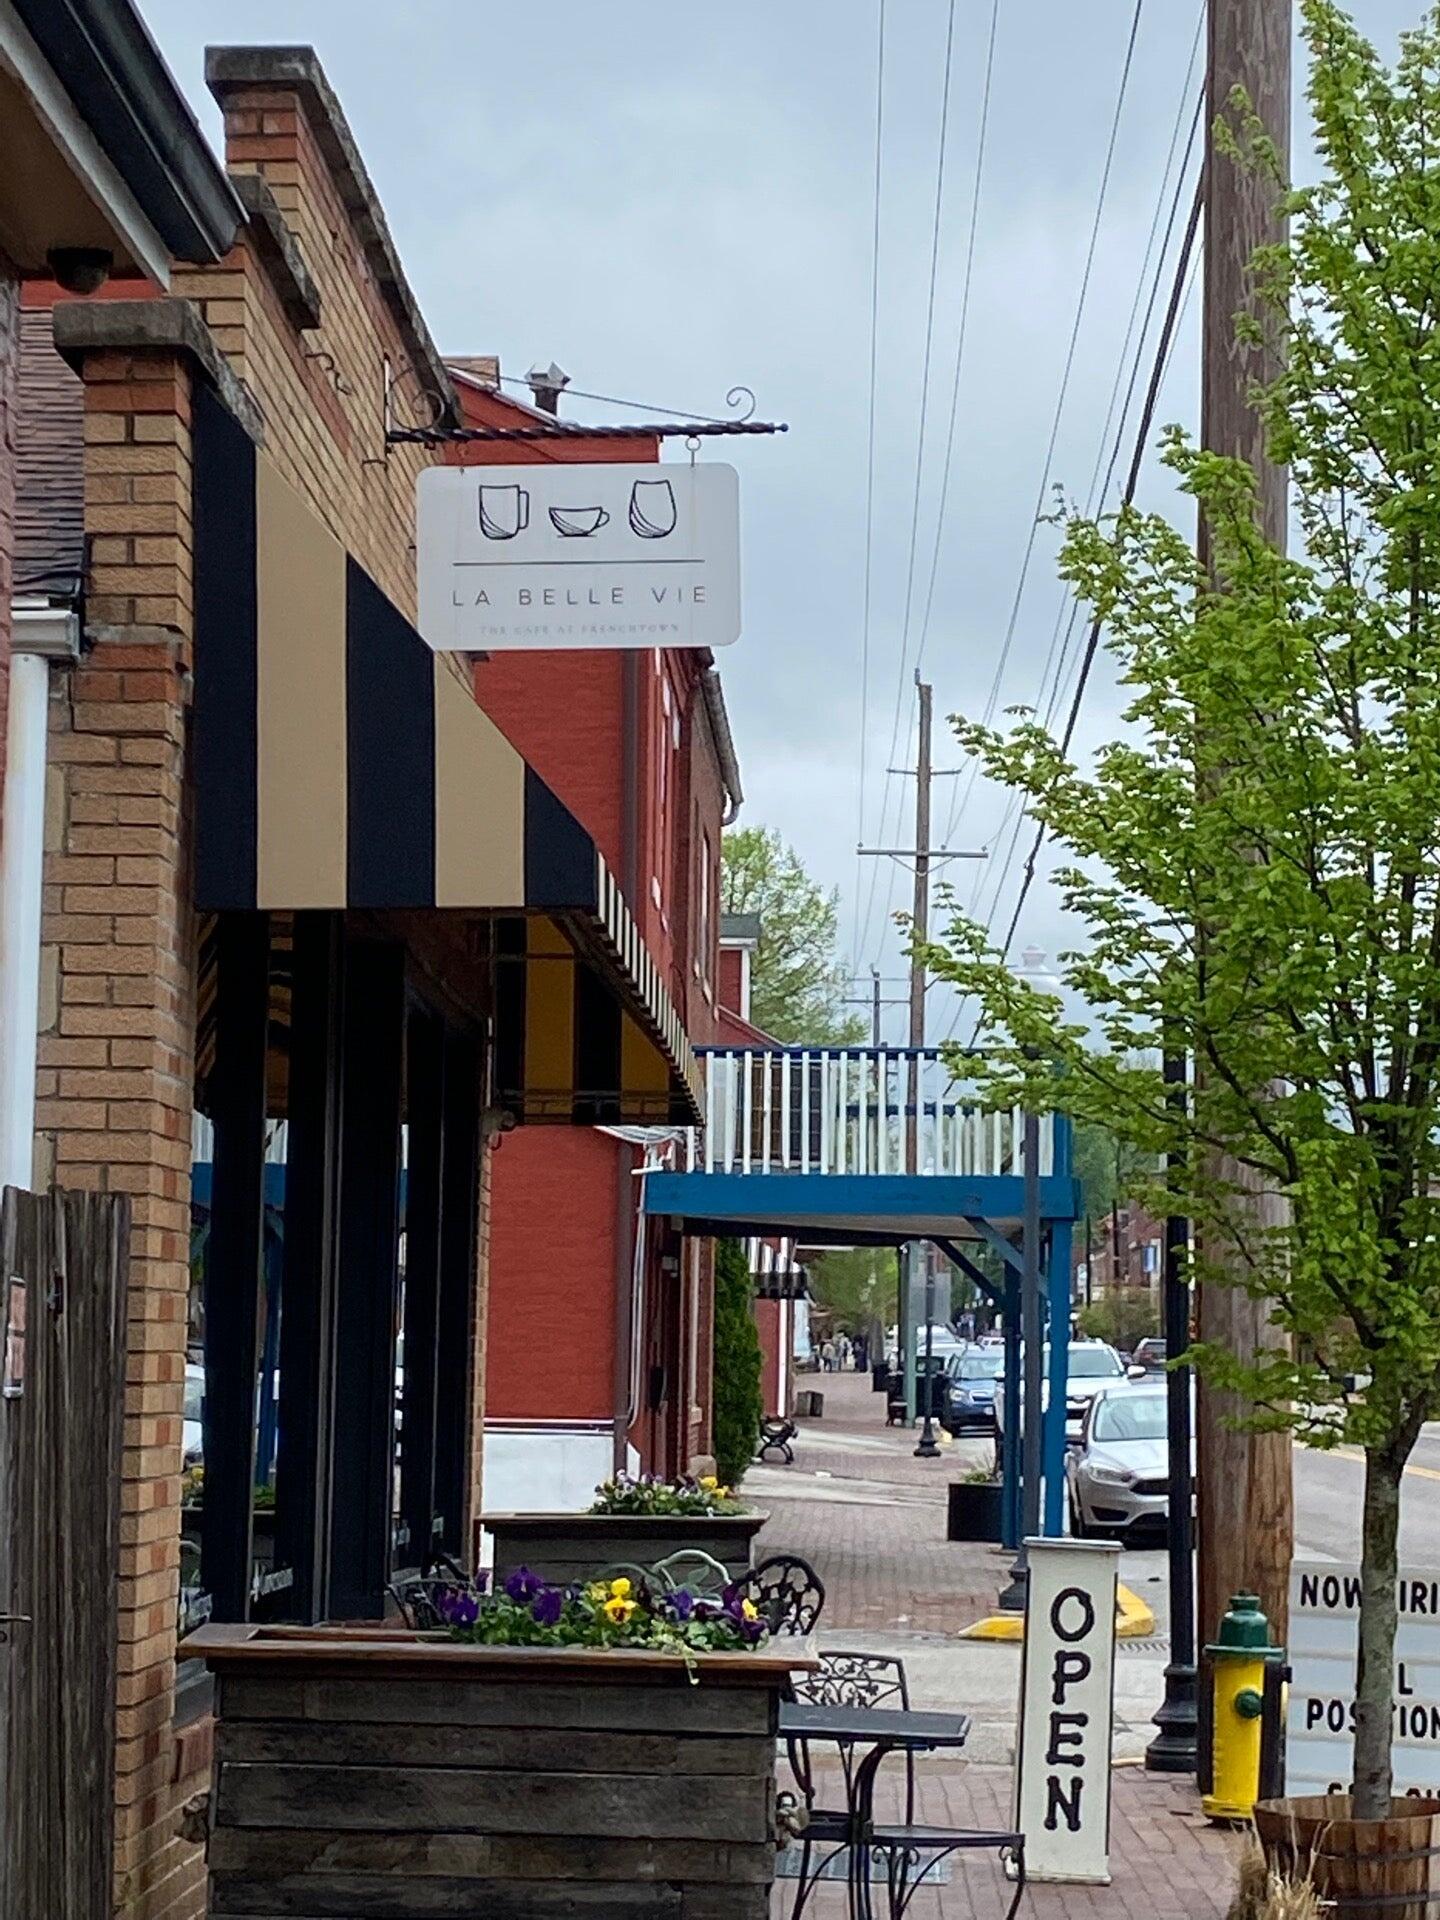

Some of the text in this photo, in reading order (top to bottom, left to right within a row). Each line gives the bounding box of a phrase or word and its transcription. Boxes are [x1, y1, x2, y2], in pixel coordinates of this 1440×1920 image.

[452, 585, 706, 606] LA BELLE VIE
[479, 625, 507, 636] THE
[580, 622, 680, 635] FRENCHTOWN
[1300, 1574, 1363, 1609] NOW
[1044, 1586, 1095, 1832] OPEN
